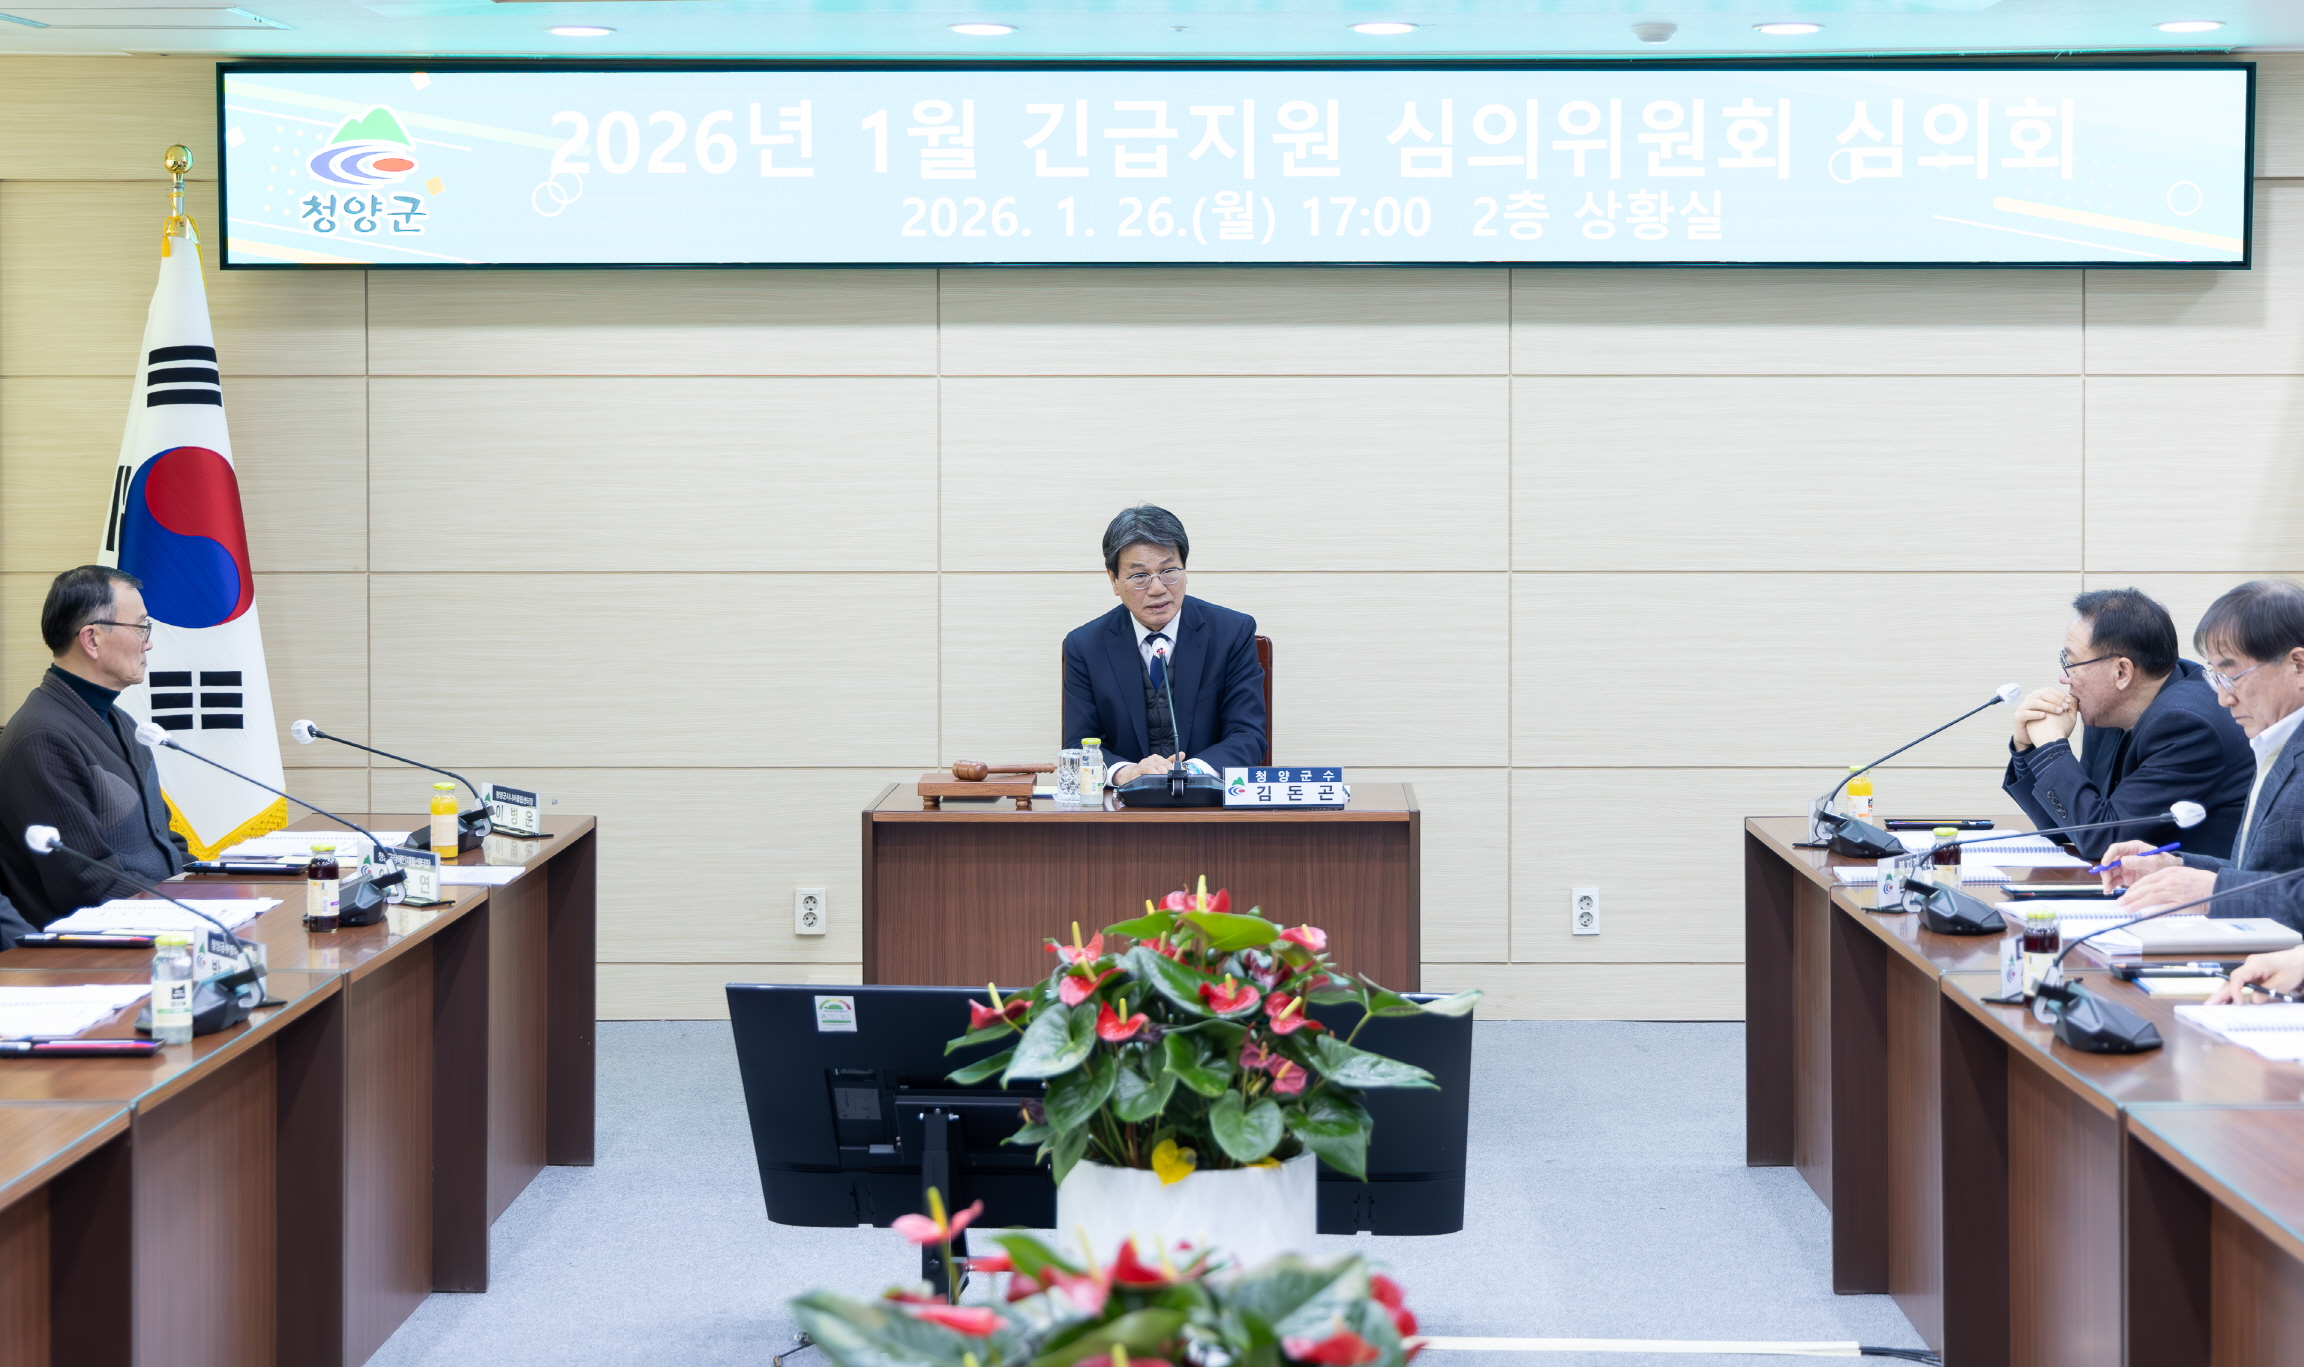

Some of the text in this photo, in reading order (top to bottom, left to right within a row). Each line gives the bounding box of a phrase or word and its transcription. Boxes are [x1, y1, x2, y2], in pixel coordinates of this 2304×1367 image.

[550, 97, 2076, 180] 2026년 1월 긴급지원 심의위원회 심의회
[301, 194, 427, 233] 청양군
[900, 188, 1723, 245] 2026. 1. 26.(월) 17:00 2층 상황실
[1255, 770, 1335, 783] 청양군수
[1256, 785, 1335, 802] 김돈곤
